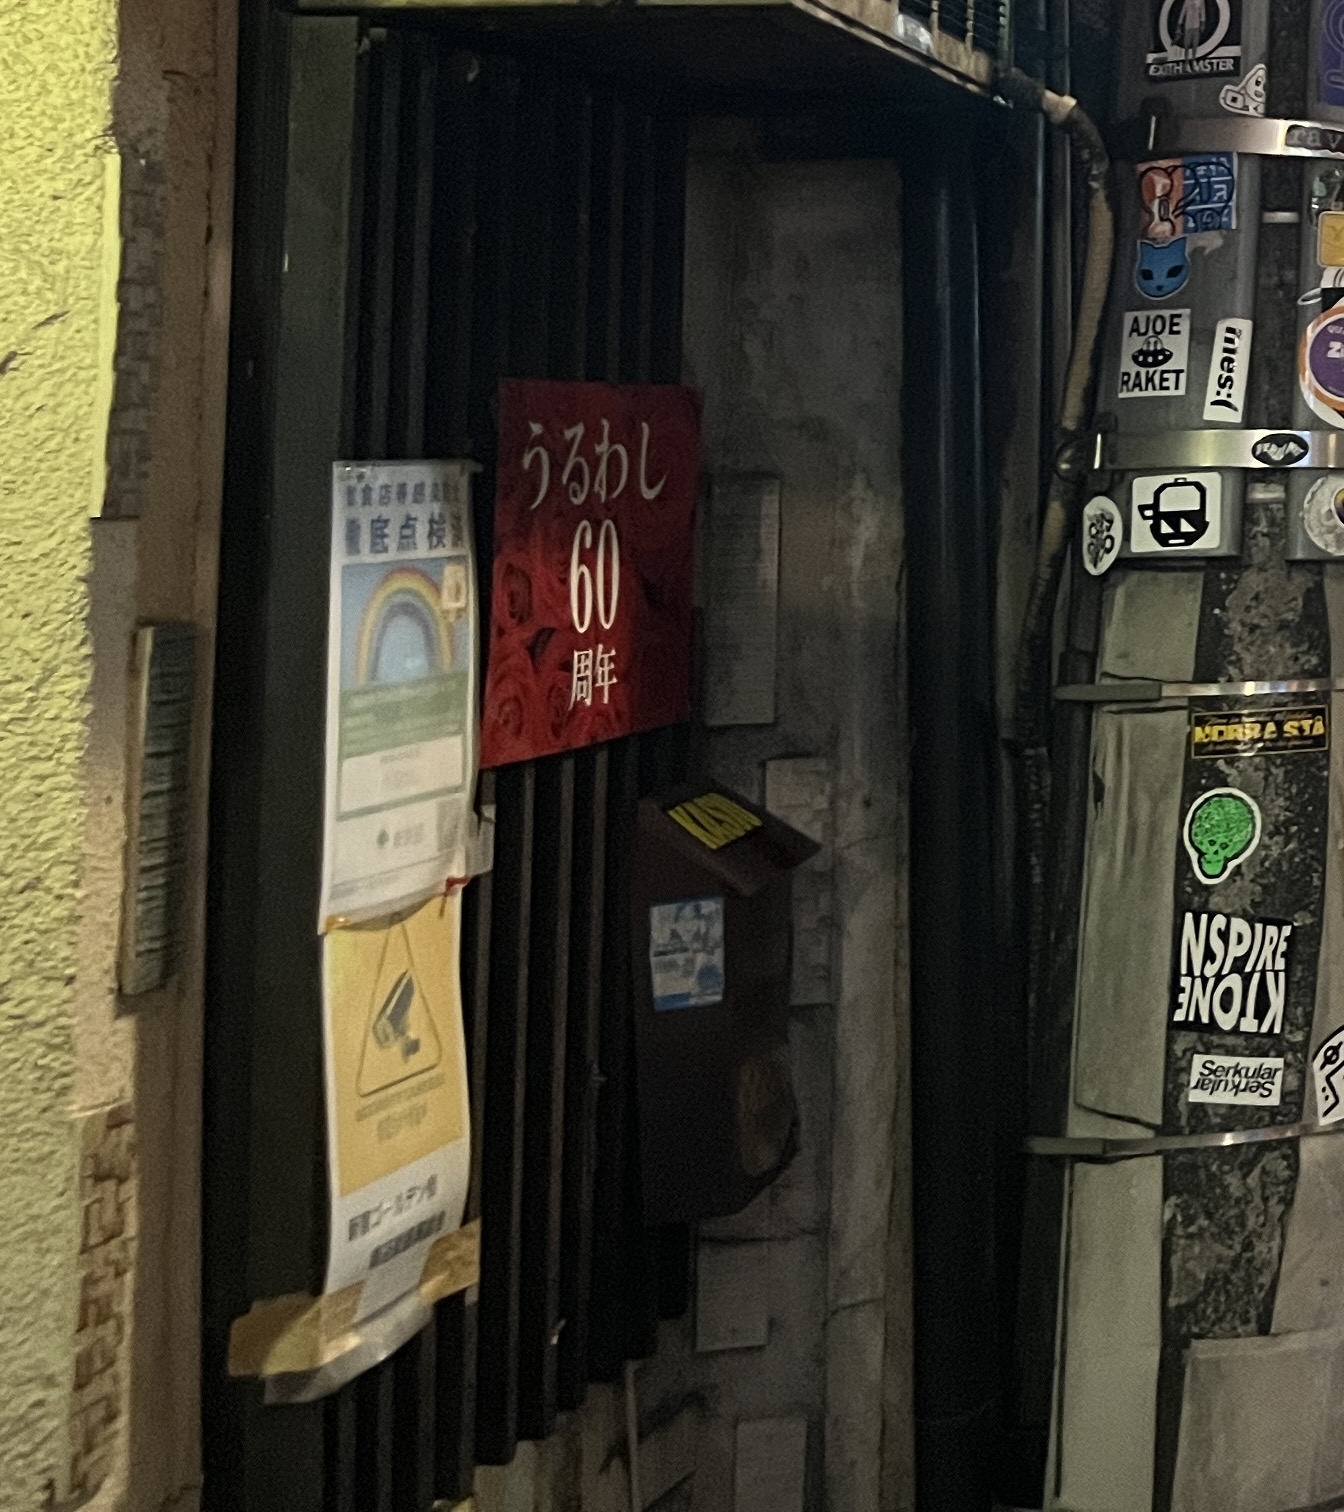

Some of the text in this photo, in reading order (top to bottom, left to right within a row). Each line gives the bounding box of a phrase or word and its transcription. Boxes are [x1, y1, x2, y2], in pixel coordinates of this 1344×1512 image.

[1129, 314, 1182, 337] AJOE
[1120, 369, 1184, 392] RAKET
[522, 418, 667, 510] うるわし
[569, 519, 620, 633] 60
[568, 644, 618, 711] 周年
[1181, 912, 1292, 977] NSPIRE
[1199, 1059, 1282, 1080] Serkular
